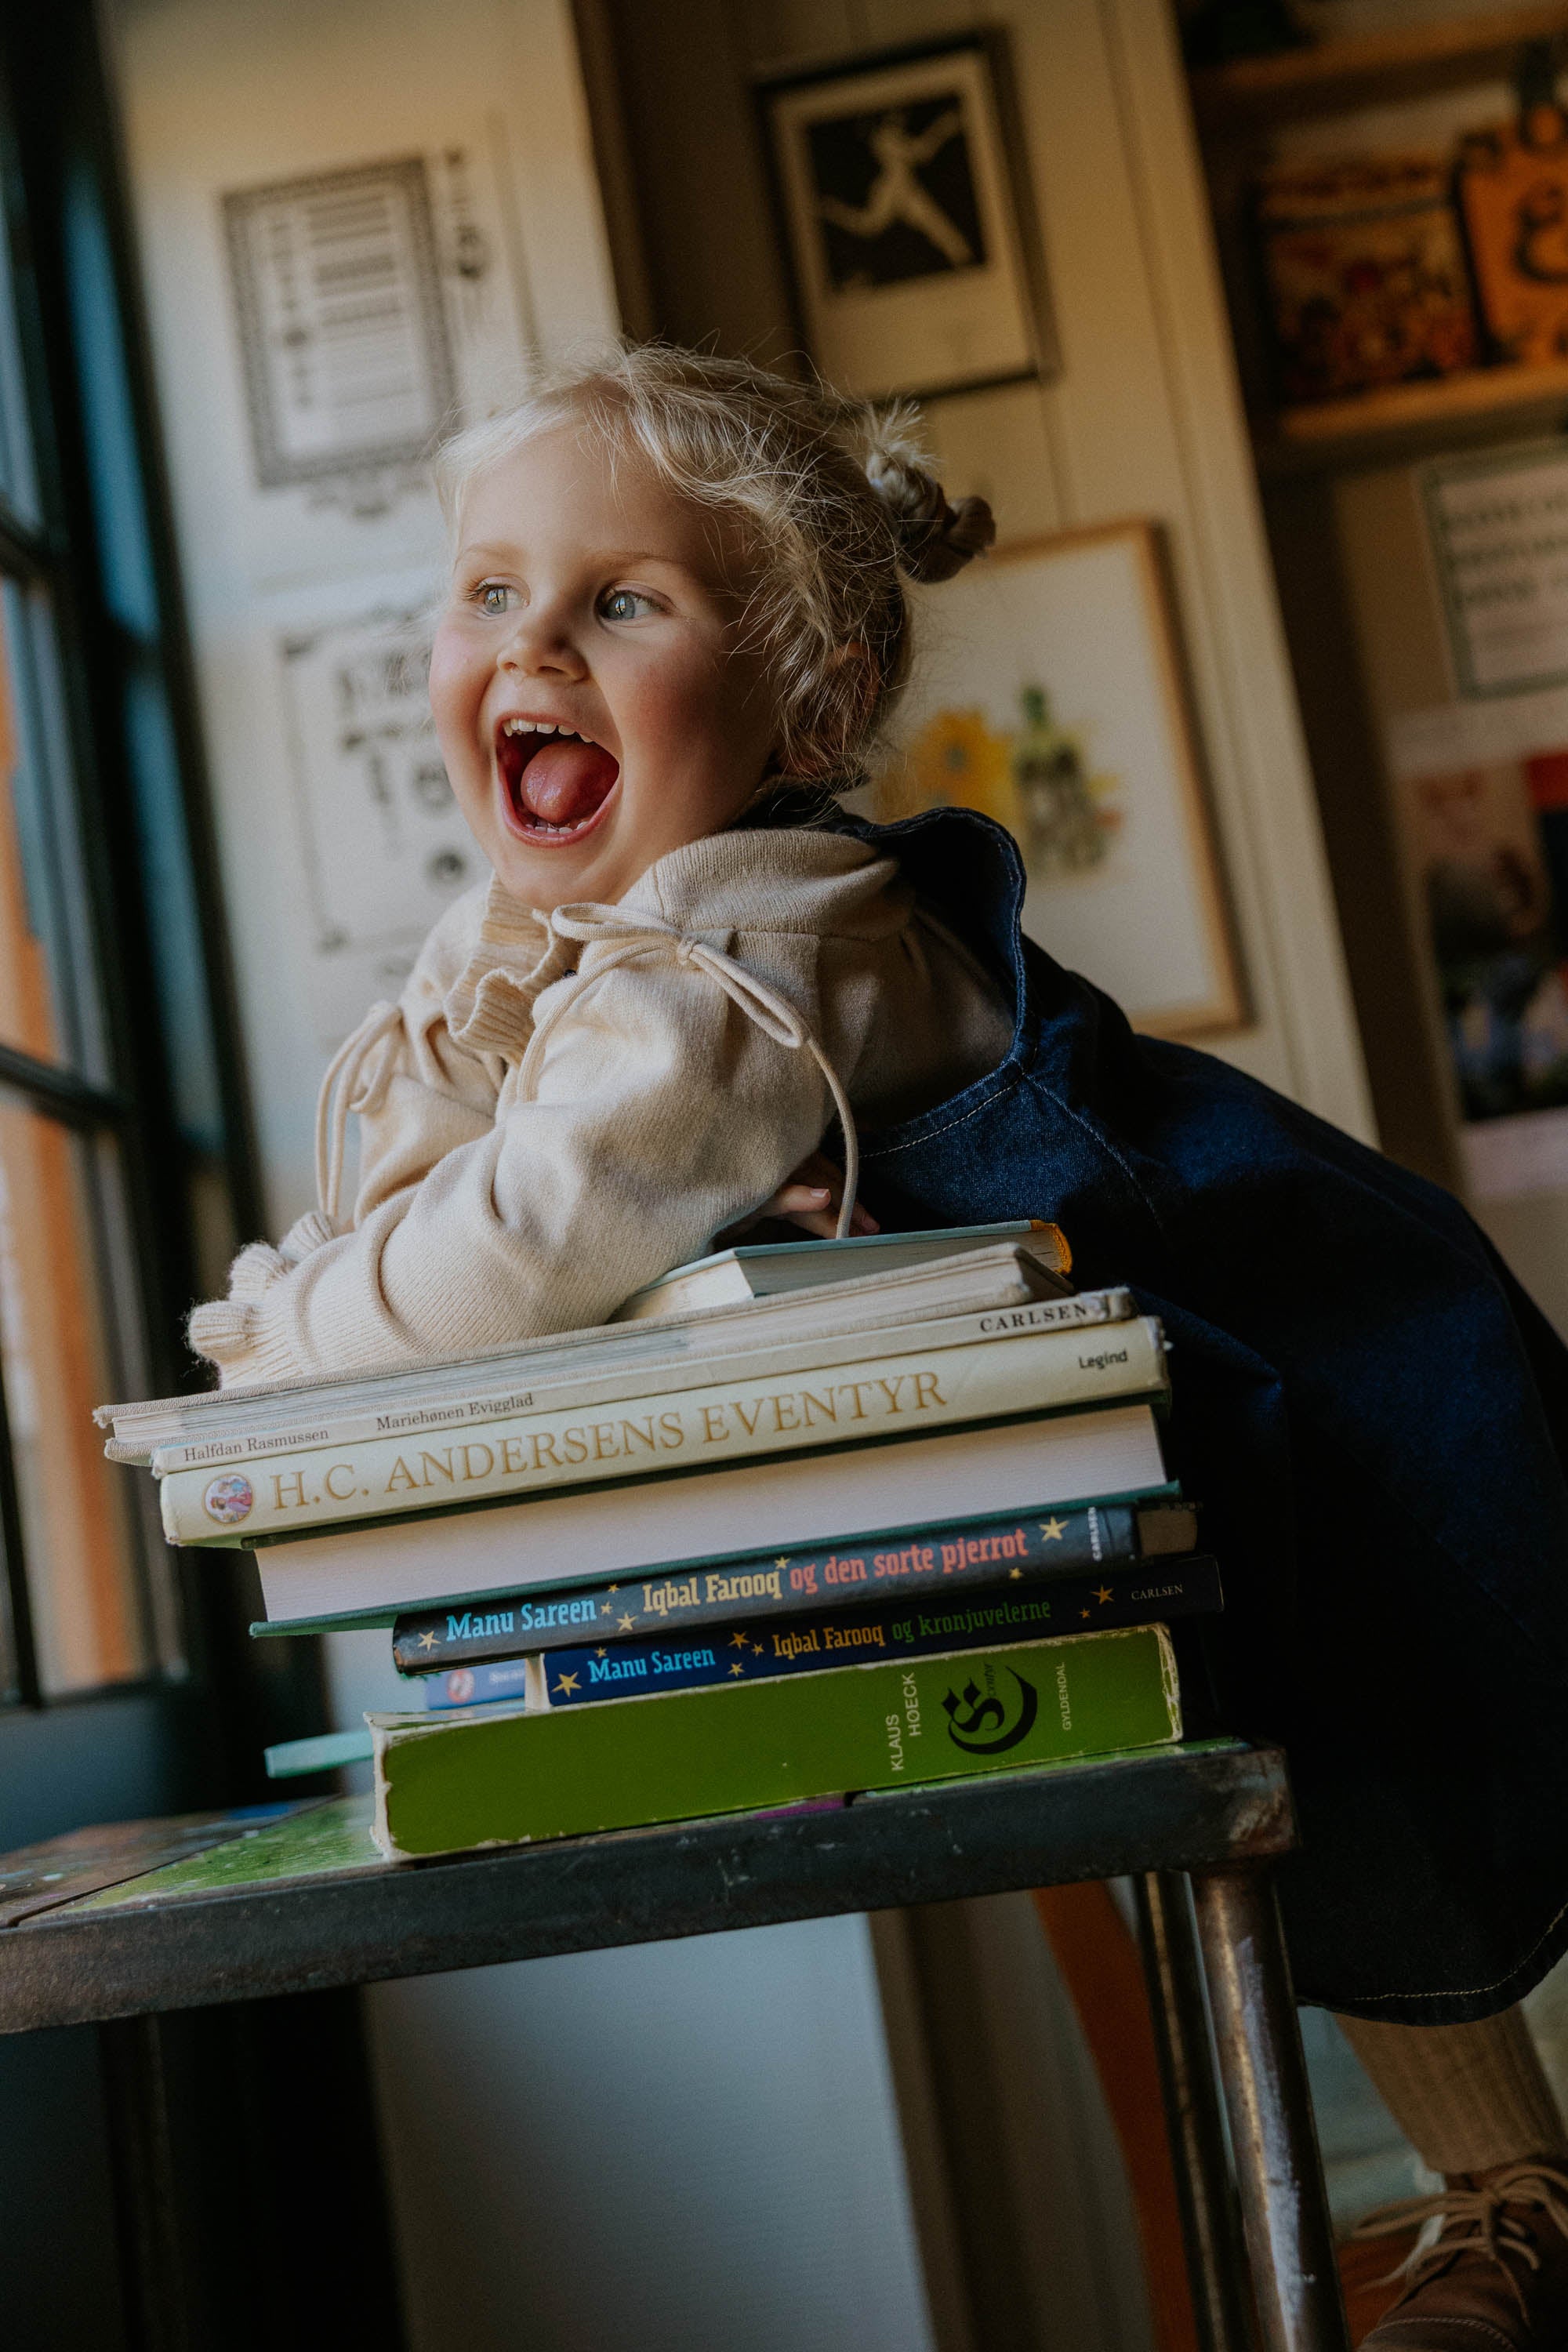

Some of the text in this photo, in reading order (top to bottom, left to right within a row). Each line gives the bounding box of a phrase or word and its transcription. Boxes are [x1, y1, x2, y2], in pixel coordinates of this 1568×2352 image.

[979, 1301, 1088, 1333] CARLSEN
[1079, 1348, 1129, 1370] Legind
[270, 1372, 946, 1509] H.C. ANDERSENS EVENTYR
[376, 1392, 534, 1432] Mariehønen Evigglad
[183, 1427, 329, 1462] Halfdan Rasmussen
[446, 1528, 1029, 1642] Manu Sareen Iqbal Farooq og den sorte pjerrot
[1131, 1584, 1184, 1600] CARLSEN
[588, 1600, 1051, 1684] Manu Sareen Iqbal Farooq og kronjuvelerne
[902, 1671, 922, 1737] HØECK
[1056, 1661, 1072, 1731] GYLDENDAL
[884, 1713, 904, 1773] KLAUS
